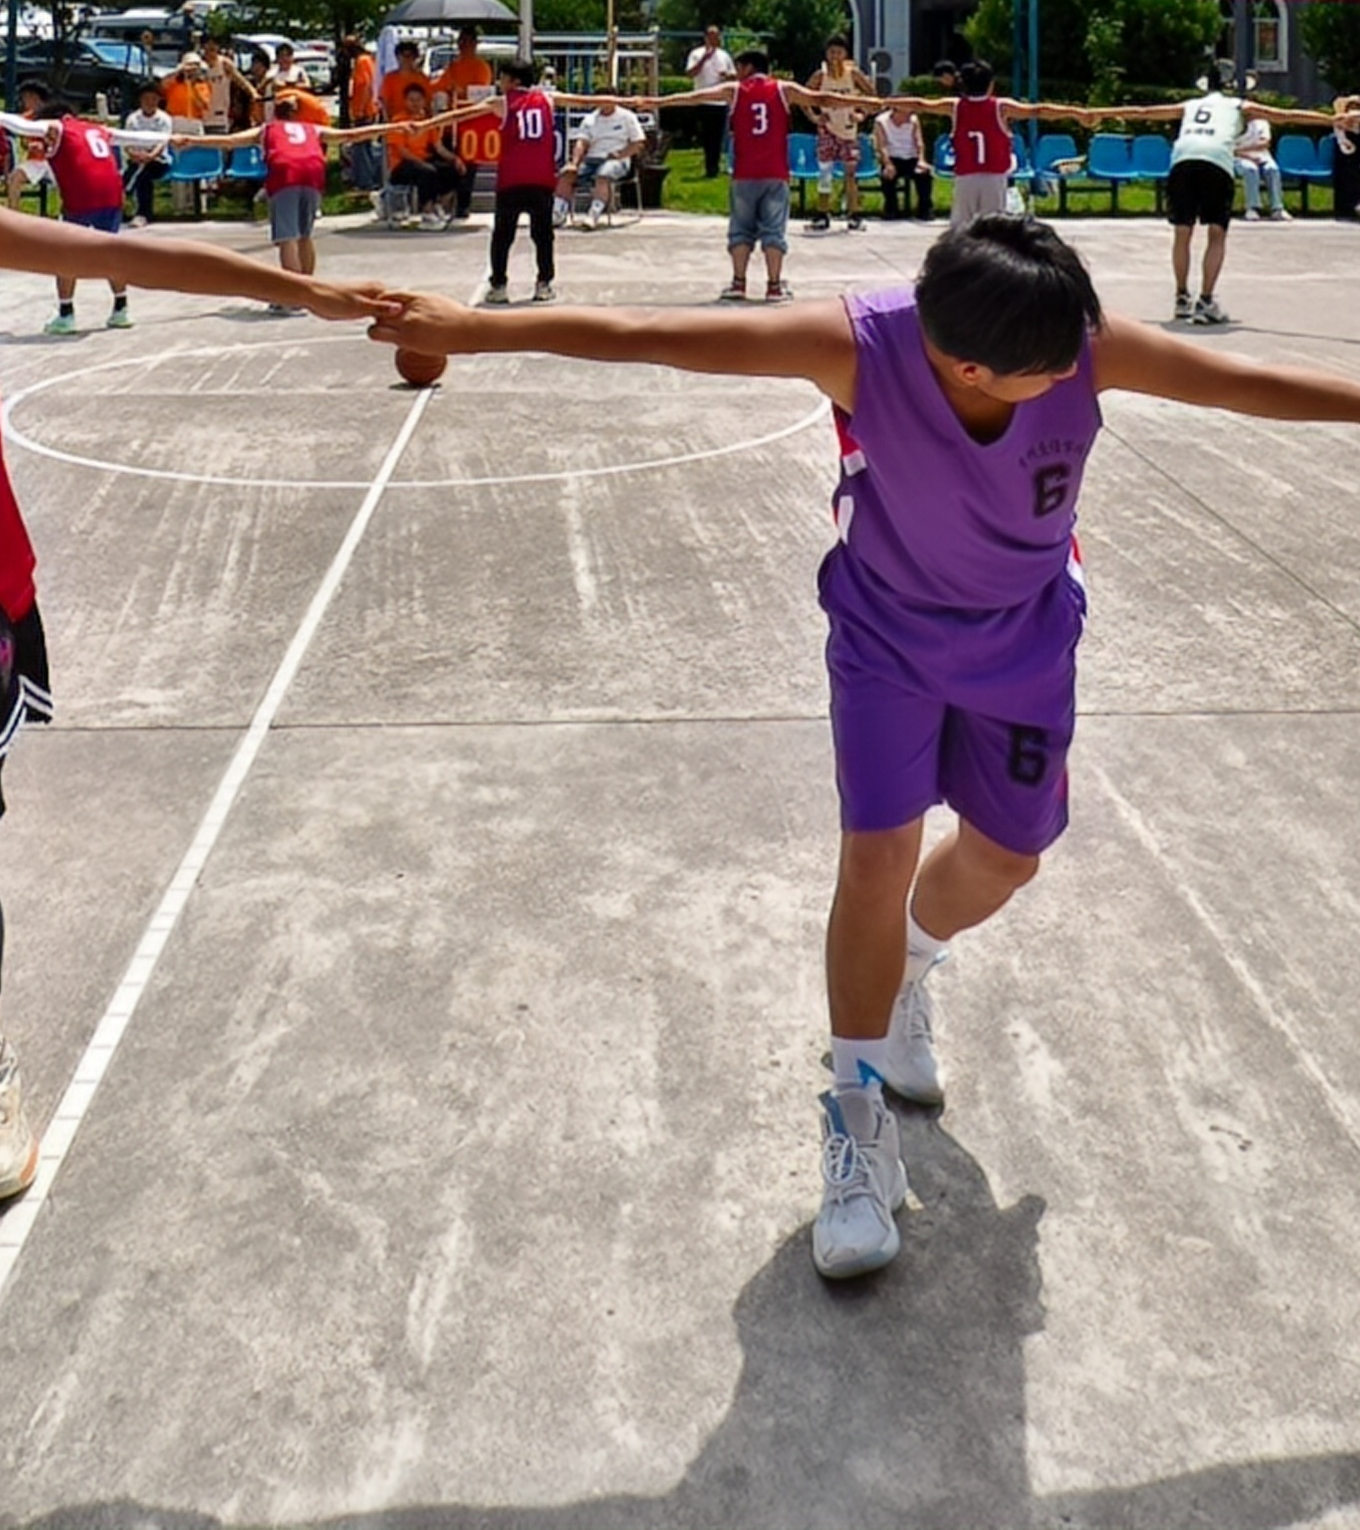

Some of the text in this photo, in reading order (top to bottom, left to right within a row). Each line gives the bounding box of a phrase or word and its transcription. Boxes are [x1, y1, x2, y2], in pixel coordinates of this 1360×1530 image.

[516, 108, 542, 139] 10
[751, 103, 768, 135] 3
[1194, 108, 1212, 124] 6
[85, 129, 110, 158] 6
[284, 122, 307, 144] 9
[1033, 462, 1071, 518] 6
[1009, 724, 1049, 788] 6
